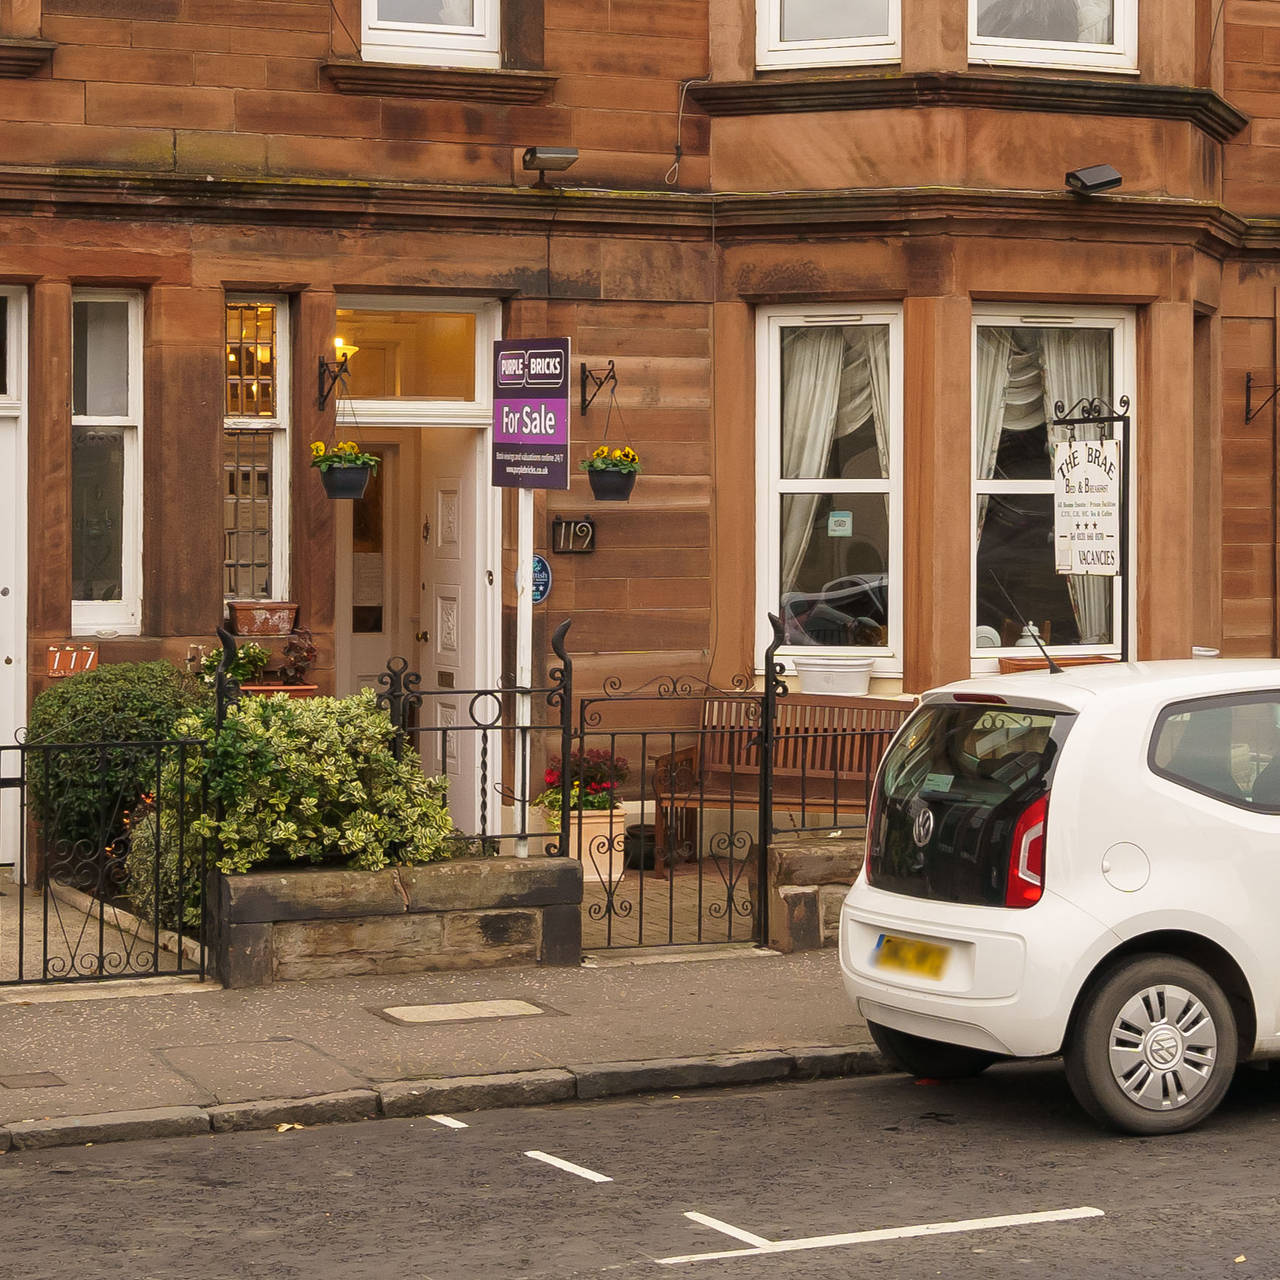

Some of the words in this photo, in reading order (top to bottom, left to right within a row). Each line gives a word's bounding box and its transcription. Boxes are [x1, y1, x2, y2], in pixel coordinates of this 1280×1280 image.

[501, 358, 524, 375] PURPLE
[530, 357, 561, 375] BRICKS
[502, 406, 520, 434] For
[522, 404, 556, 434] Sale
[1057, 449, 1080, 480] THE
[1087, 446, 1117, 481] BRAE
[560, 522, 593, 550] 119
[1078, 549, 1115, 566] VACANCIES
[53, 651, 96, 670] 117
